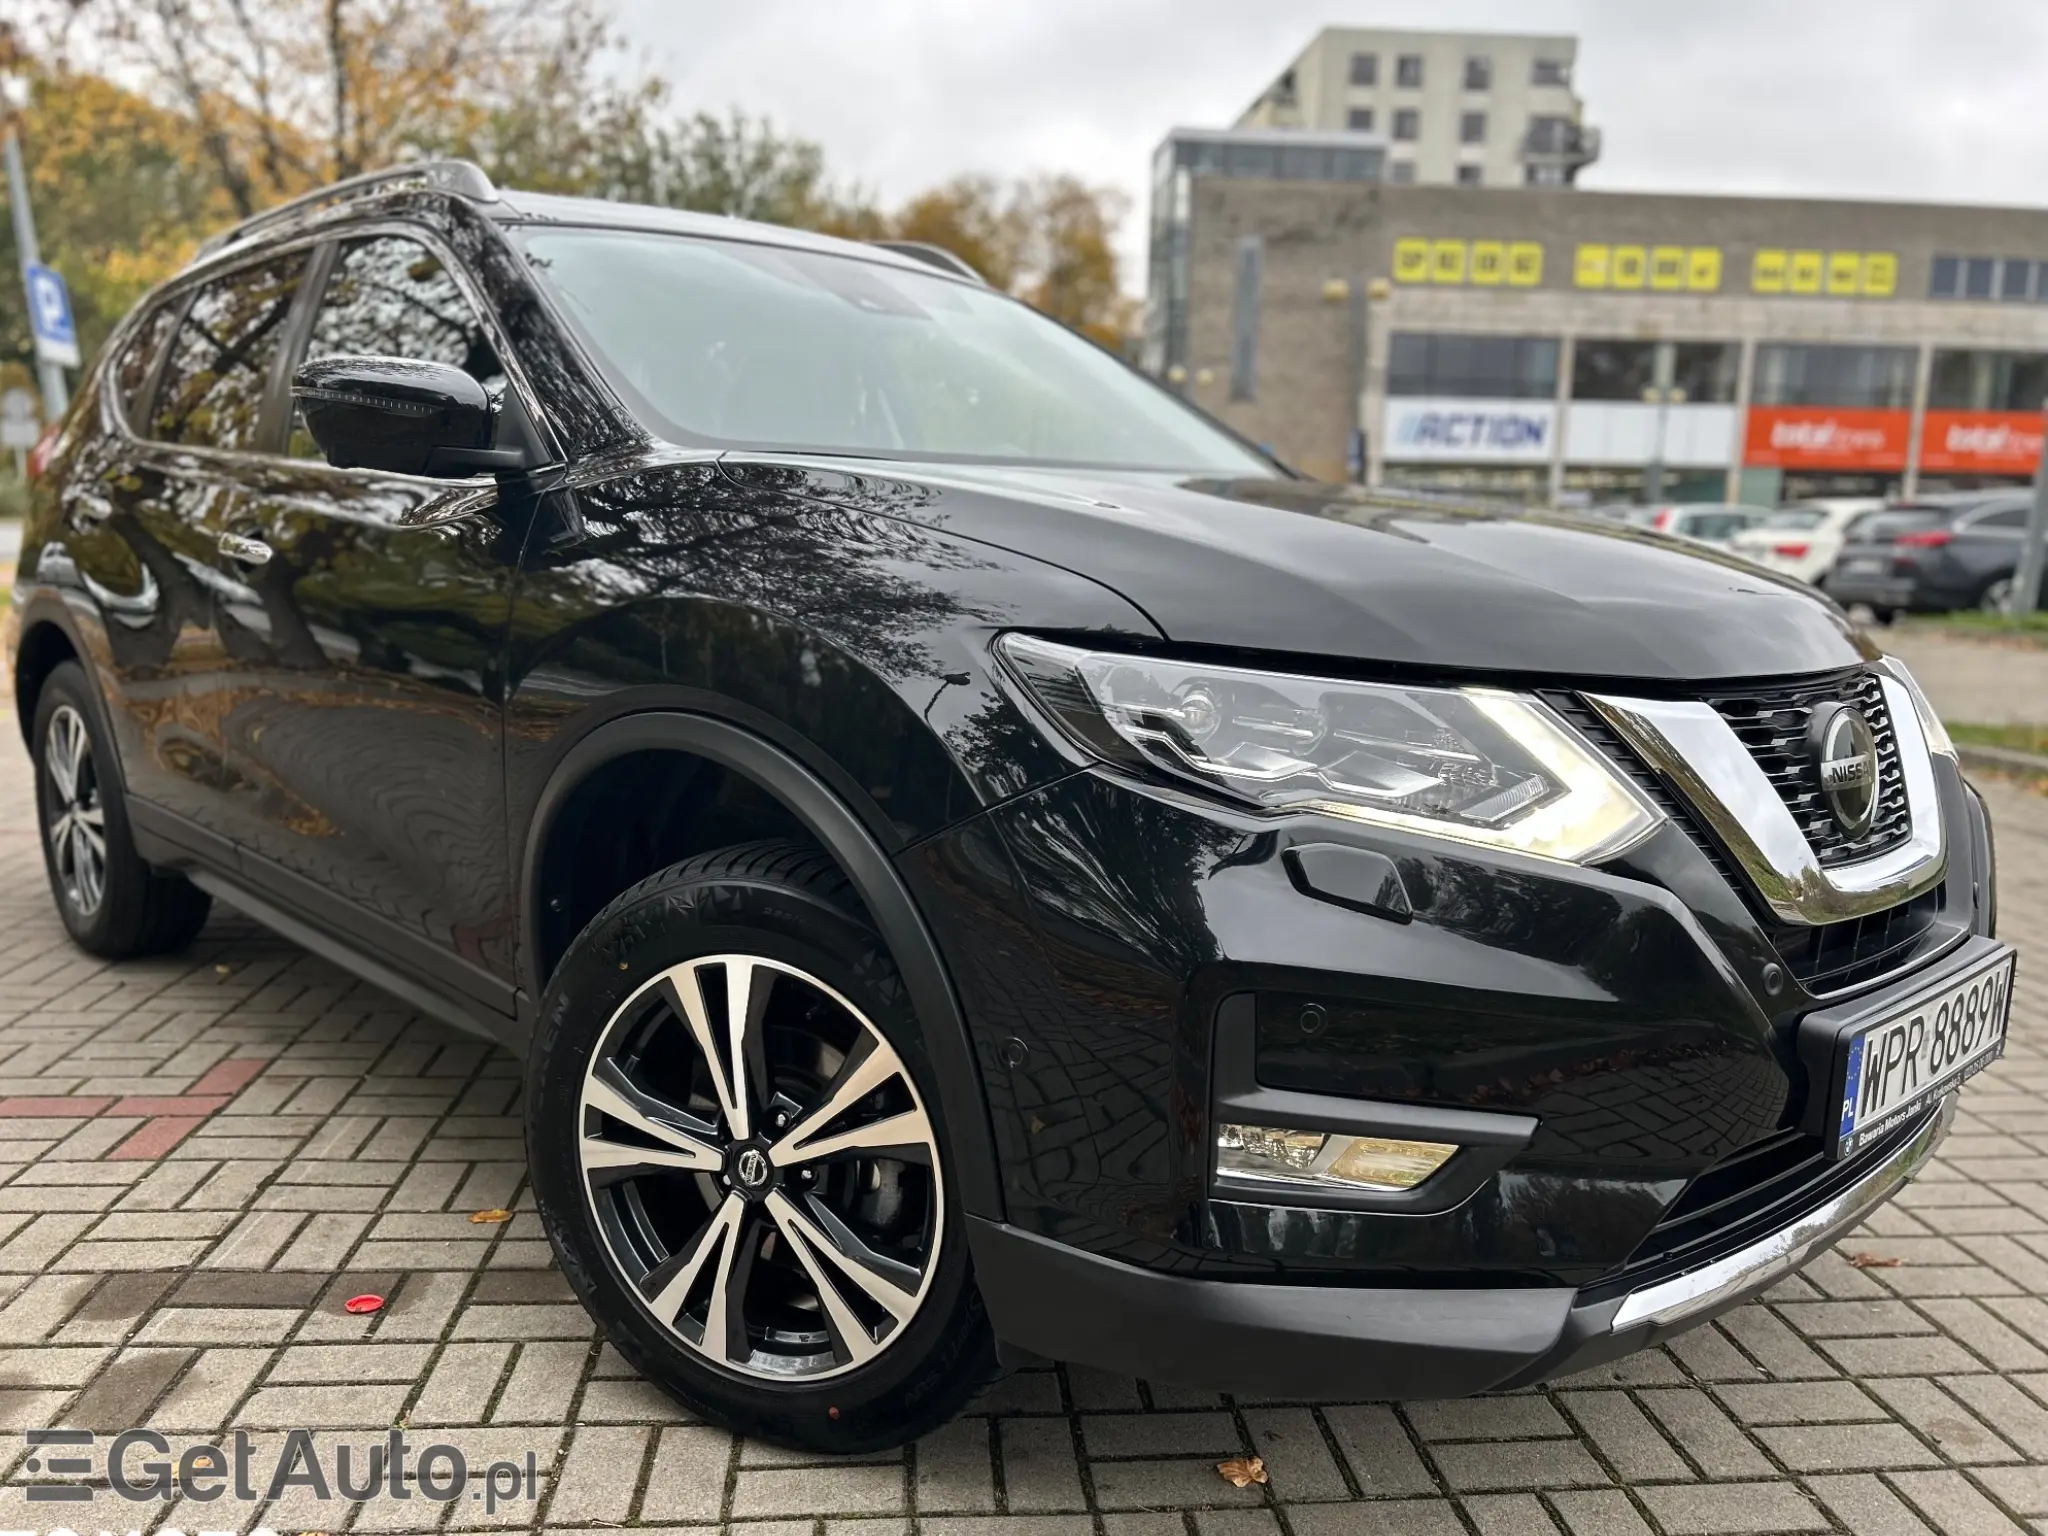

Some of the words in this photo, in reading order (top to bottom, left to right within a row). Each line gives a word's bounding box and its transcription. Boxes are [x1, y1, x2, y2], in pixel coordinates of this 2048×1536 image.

[1412, 412, 1548, 447] ACTION
[1832, 760, 1872, 784] NISSA
[1860, 1015, 1925, 1118] WPR
[1930, 965, 2010, 1075] 8889W
[1841, 1097, 1854, 1122] PL
[1859, 1122, 1884, 1147] Bawaria
[1885, 1111, 1906, 1132] Motors
